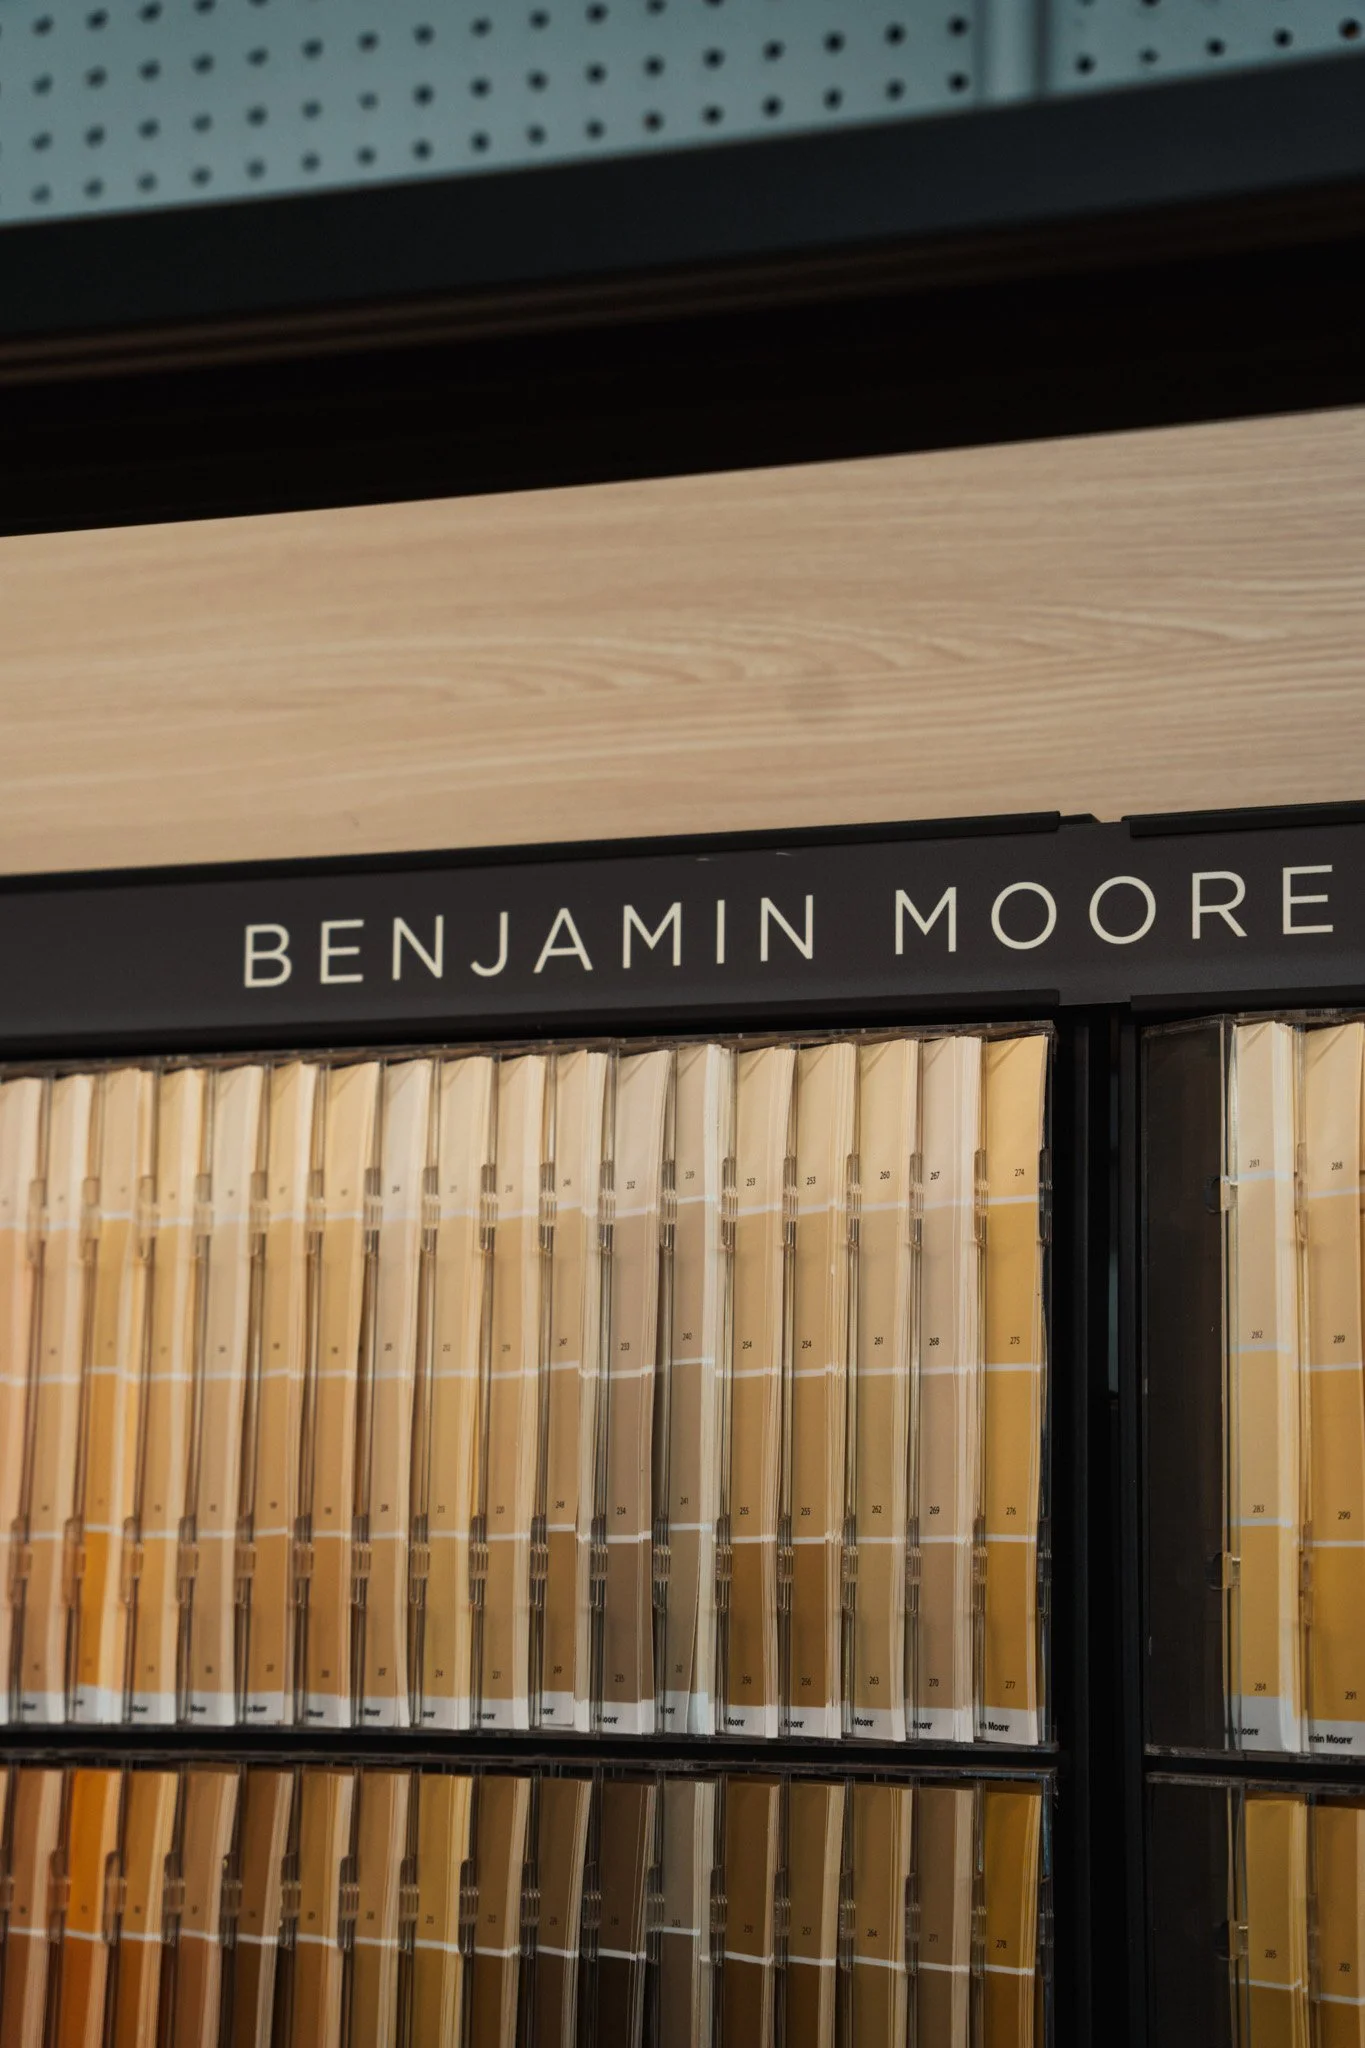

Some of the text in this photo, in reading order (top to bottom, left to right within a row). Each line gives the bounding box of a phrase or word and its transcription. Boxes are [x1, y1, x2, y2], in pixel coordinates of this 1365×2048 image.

[244, 864, 1334, 988] BENJAMIN MOORE
[1249, 1159, 1261, 1168] 281
[1331, 1161, 1343, 1171] 288
[879, 1170, 891, 1180] 260
[930, 1171, 941, 1181] 267
[1014, 1168, 1025, 1177] 274
[746, 1177, 756, 1187] 253
[806, 1176, 817, 1185] 253
[1251, 1330, 1263, 1340] 282
[1333, 1334, 1346, 1345] 289
[742, 1341, 753, 1349] 254
[801, 1340, 812, 1349] 254
[874, 1336, 884, 1345] 261
[929, 1337, 940, 1347] 268
[1009, 1336, 1021, 1345] 275
[620, 1342, 630, 1351] 233
[680, 1497, 689, 1505] 241
[616, 1506, 626, 1515] 234
[739, 1506, 749, 1515] 255
[801, 1507, 811, 1516] 255
[871, 1505, 882, 1514] 262
[929, 1505, 940, 1515] 269
[1006, 1507, 1017, 1516] 276
[1252, 1504, 1265, 1514] 283
[1338, 1511, 1351, 1521] 290
[801, 1677, 812, 1687] 256
[869, 1676, 880, 1685] 263
[928, 1678, 939, 1687] 270
[1005, 1680, 1016, 1689] 277
[1254, 1682, 1267, 1692] 284
[1344, 1690, 1357, 1701] 291
[988, 1722, 1010, 1732] Moore
[1326, 1734, 1353, 1745] Moore
[867, 1928, 879, 1938] 264
[928, 1933, 939, 1943] 271
[995, 1939, 1007, 1949] 278
[1264, 1949, 1277, 1959] 285
[1339, 1963, 1351, 1973] 292
